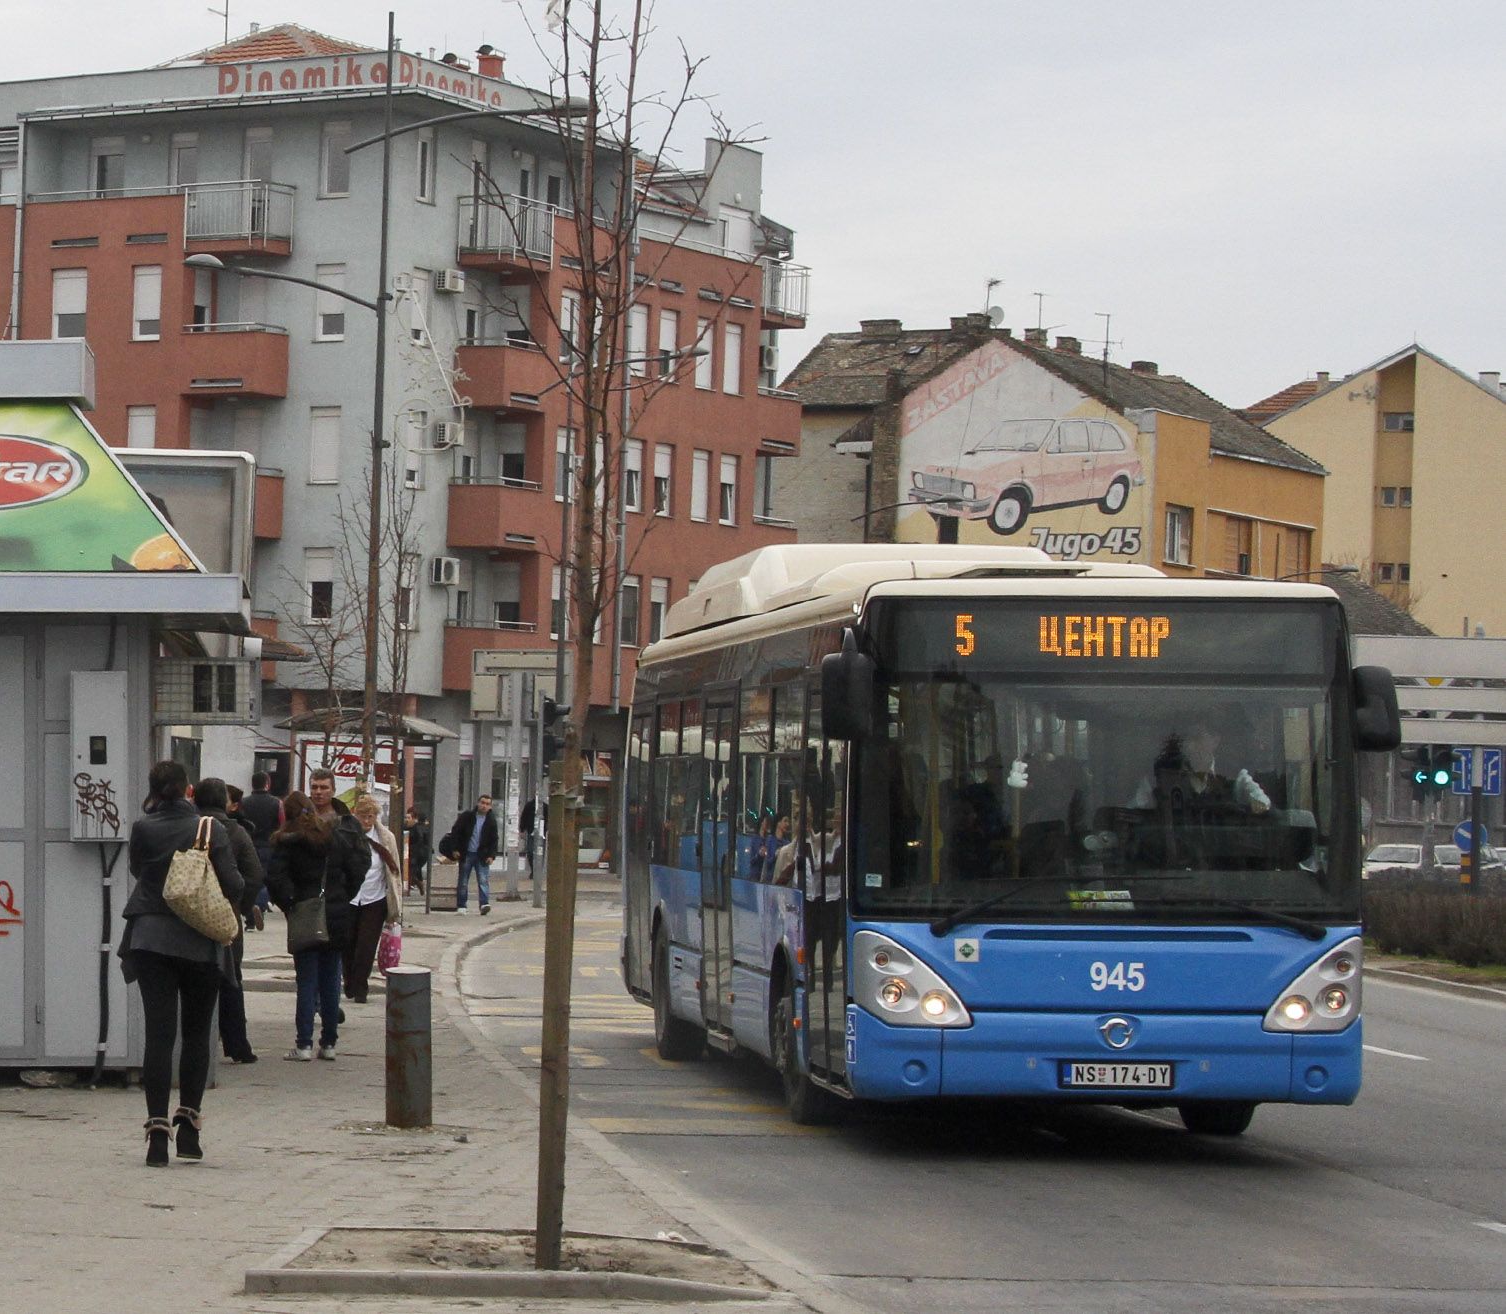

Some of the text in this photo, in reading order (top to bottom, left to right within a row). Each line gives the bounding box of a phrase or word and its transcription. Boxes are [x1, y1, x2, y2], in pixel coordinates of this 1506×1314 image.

[218, 57, 390, 95] Dinamika
[399, 55, 502, 107] Dinamika
[1030, 527, 1142, 561] Jugo 45
[956, 615, 1170, 657] 5 ЦЕНТАР
[1089, 961, 1145, 991] 945
[1075, 1066, 1168, 1083] NS 174-DY
